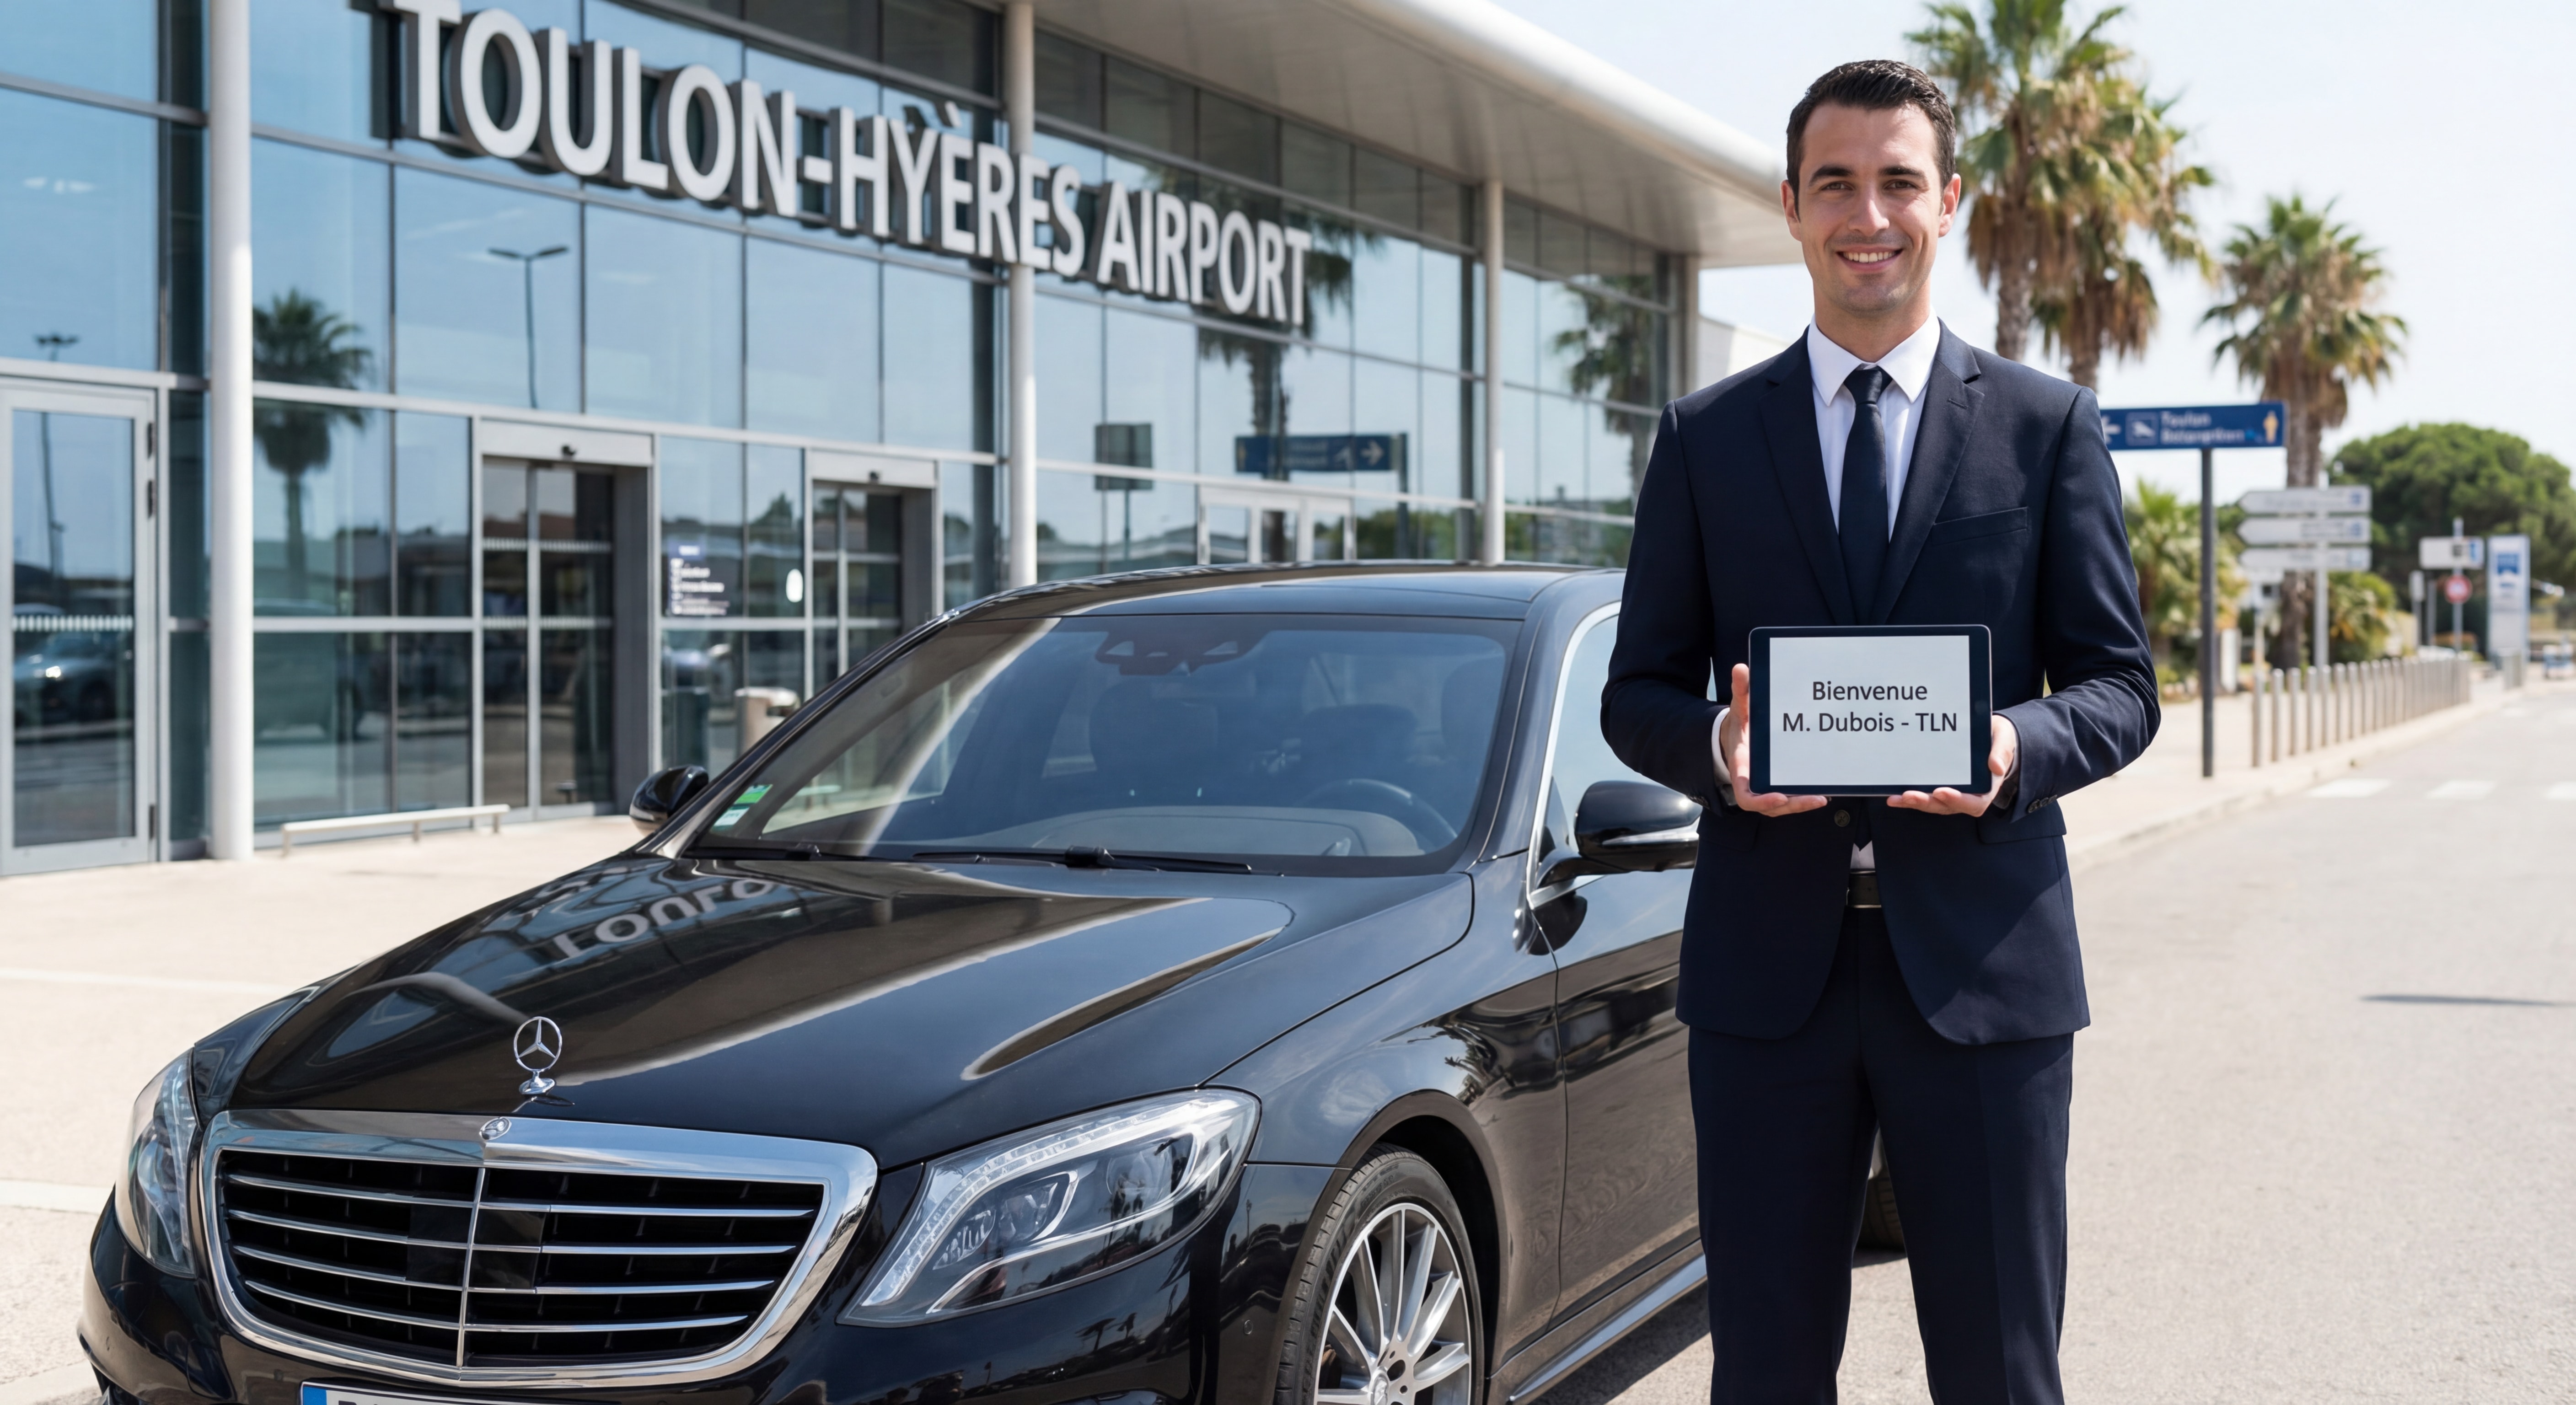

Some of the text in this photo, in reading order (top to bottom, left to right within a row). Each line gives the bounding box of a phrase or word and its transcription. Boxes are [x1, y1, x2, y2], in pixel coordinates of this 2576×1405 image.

[392, 0, 1312, 326] TOULON-HYÈRES AIRPORT
[1813, 681, 1927, 701] Bienvenue
[1783, 713, 1810, 732] M.
[1819, 711, 1894, 732] Dubois
[1915, 712, 1957, 732] TLN
